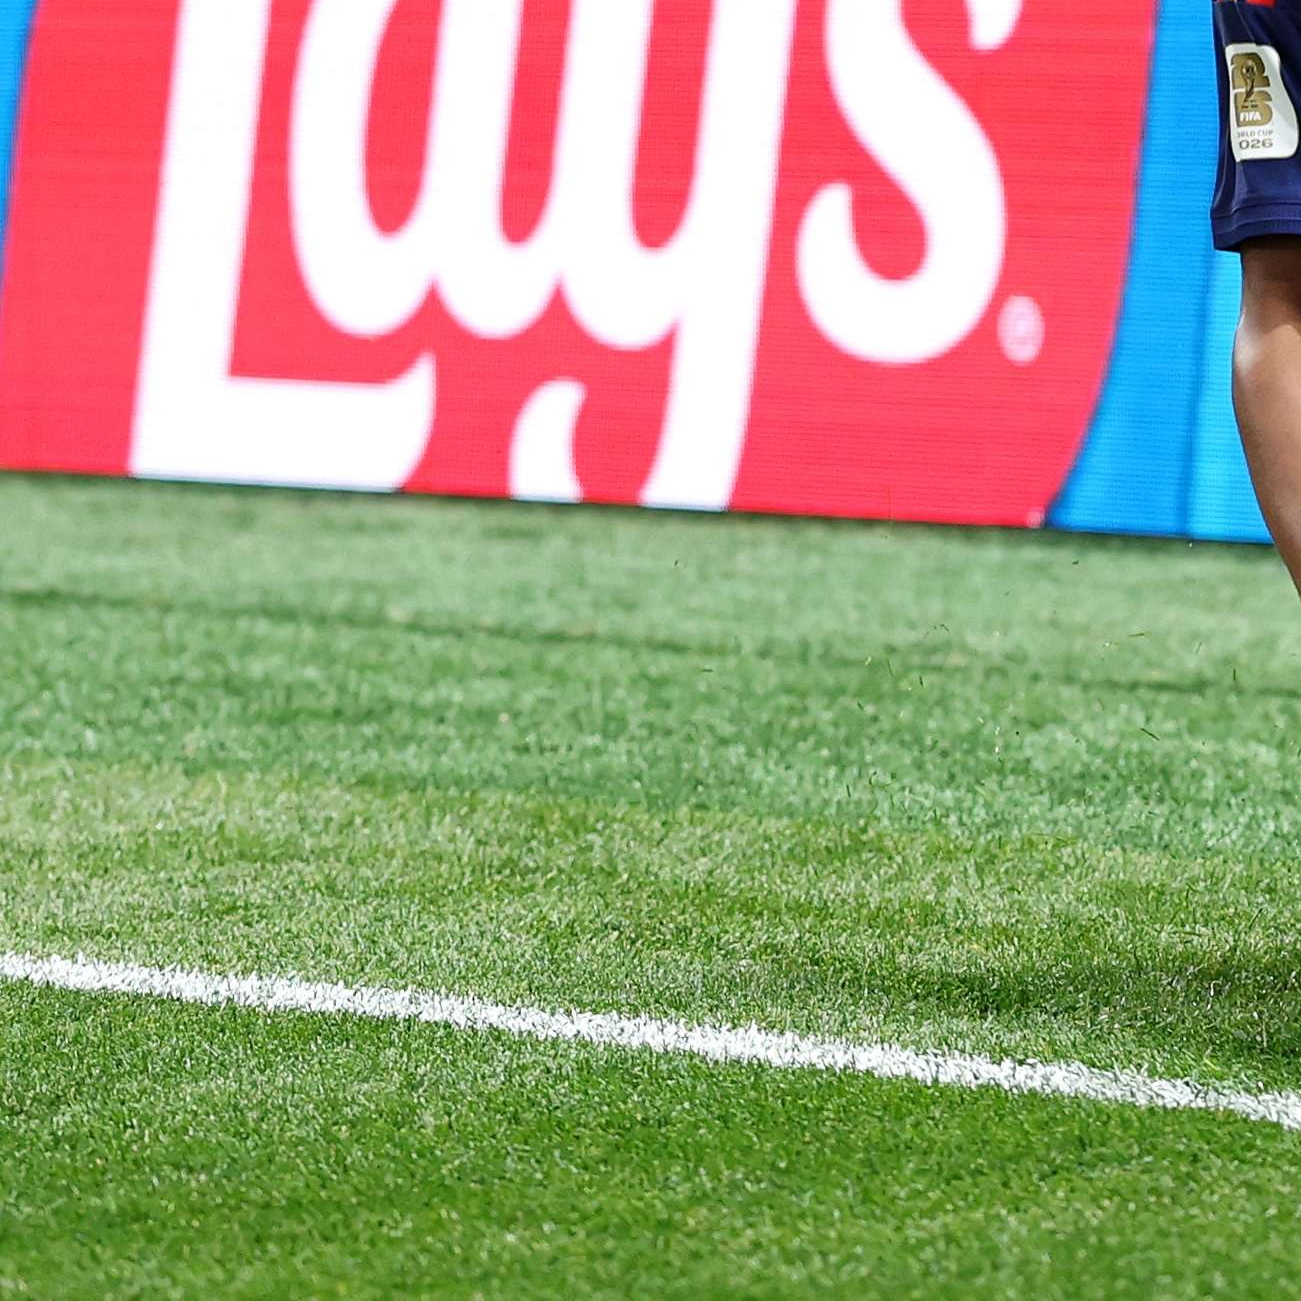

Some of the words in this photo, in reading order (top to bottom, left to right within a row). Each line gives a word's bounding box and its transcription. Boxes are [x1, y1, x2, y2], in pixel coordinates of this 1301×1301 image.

[1240, 111, 1262, 122] FIFA
[1257, 129, 1274, 137] CUP
[1239, 139, 1274, 150] 026
